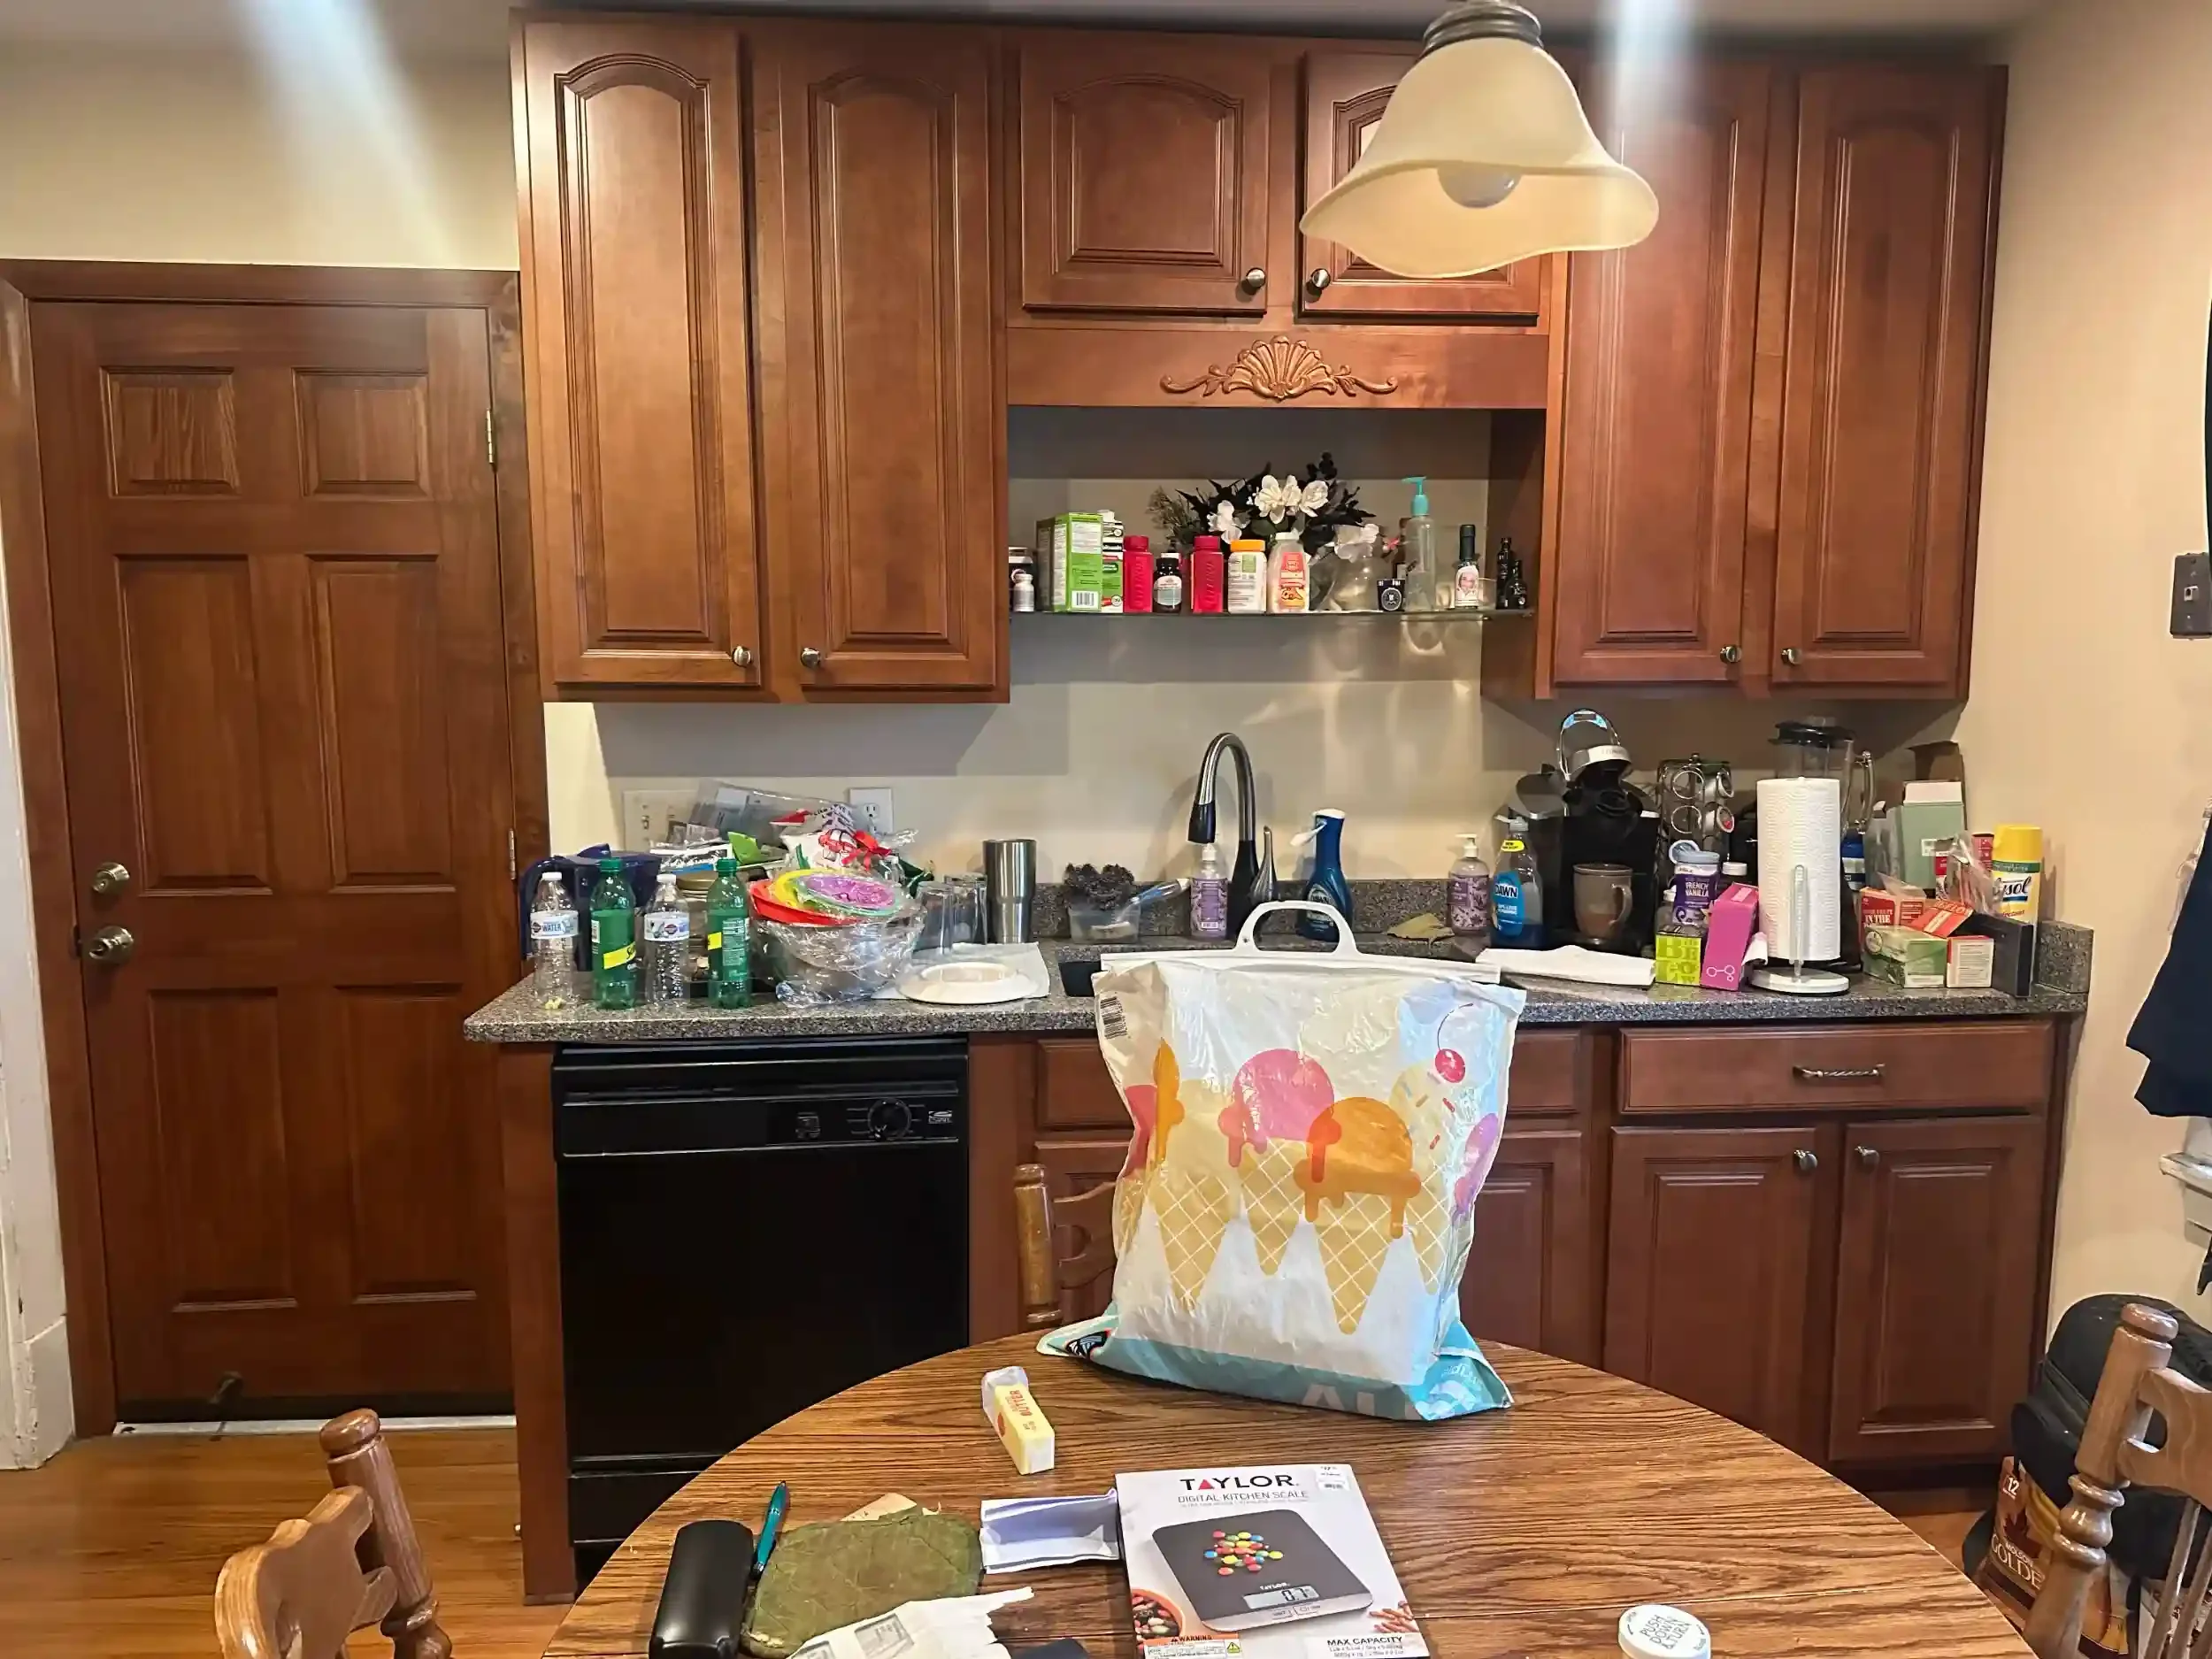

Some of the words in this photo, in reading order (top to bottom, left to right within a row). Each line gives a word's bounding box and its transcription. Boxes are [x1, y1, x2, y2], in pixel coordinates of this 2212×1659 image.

[1495, 884, 1517, 898] DAWN
[541, 922, 561, 932] WATER
[1875, 914, 1891, 924] THE
[1010, 1389, 1033, 1417] BUTTER
[1179, 1473, 1295, 1491] TAYLOR
[2007, 1476, 2020, 1496] 12
[1178, 1493, 1218, 1503] DIGITAL
[1221, 1492, 1271, 1502] KITCHEN
[1272, 1490, 1309, 1499] SCALE
[1991, 1532, 2046, 1591] GOLDE
[1639, 1614, 1664, 1638] PUSH
[1649, 1616, 1681, 1644] DOWN
[1352, 1635, 1403, 1645] CAPACITY
